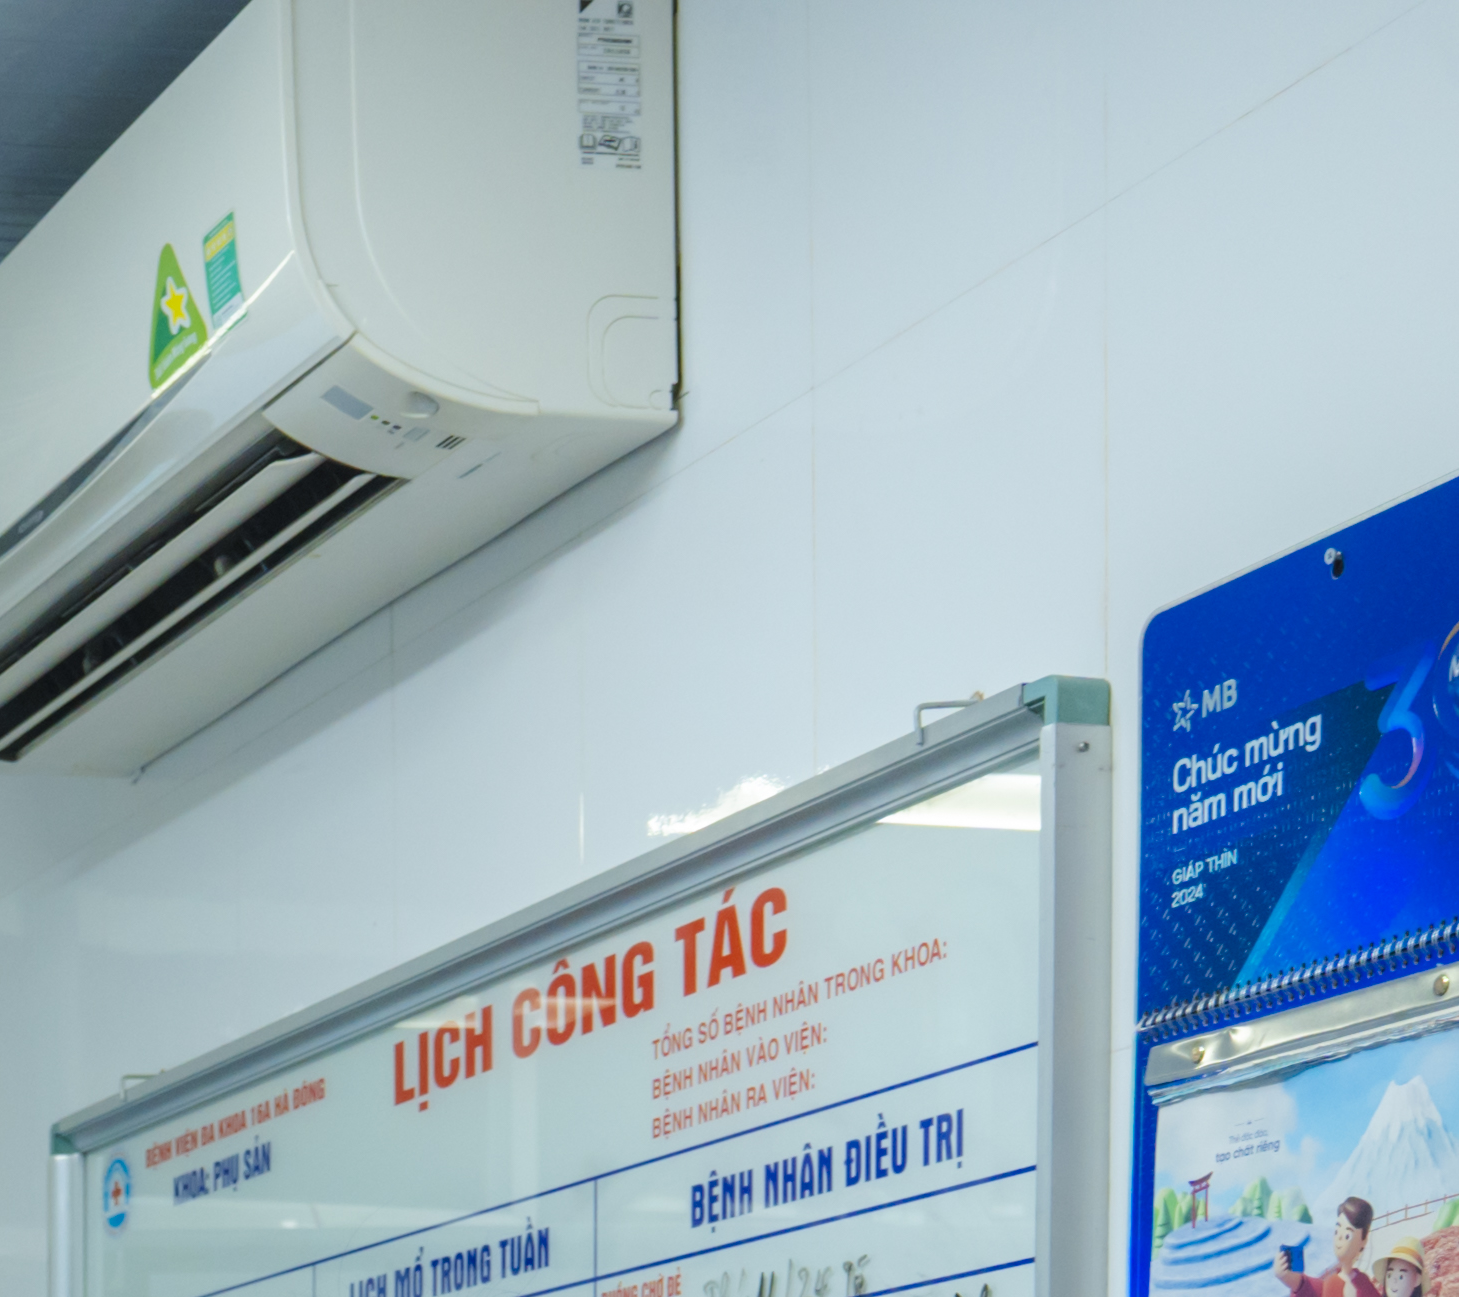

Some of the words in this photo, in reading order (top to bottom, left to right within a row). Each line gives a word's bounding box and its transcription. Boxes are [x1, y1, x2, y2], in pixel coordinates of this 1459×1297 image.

[1201, 678, 1237, 719] MB
[1173, 742, 1239, 793] Chúc
[1245, 714, 1323, 768] mừng
[1172, 791, 1226, 835] năm
[1233, 762, 1283, 812] mới
[1171, 860, 1204, 885] GIÁP
[1205, 848, 1238, 873] THÌN
[1171, 883, 1204, 908] 2024
[393, 1004, 494, 1113] LỊCH
[511, 957, 656, 1060] CÔNG
[674, 885, 789, 998] TÁC
[652, 1021, 694, 1061] TỔNG
[697, 1006, 721, 1044] SỐ
[723, 998, 768, 1037] BỆNH
[772, 980, 820, 1018] NHÂN
[823, 957, 886, 1005] TRONG
[891, 938, 948, 979] KHOA:
[652, 1066, 694, 1102] BỆNH
[697, 1047, 742, 1089] NHÂN
[745, 1034, 780, 1071] VÀO
[783, 1021, 828, 1058] VIỆN:
[218, 1108, 247, 1141] KHOA
[251, 1099, 271, 1127] 16A
[652, 1107, 694, 1141] BỆNH
[697, 1088, 742, 1129] NHÂN
[745, 1082, 769, 1114] RA
[770, 1067, 817, 1106] VIỆN:
[213, 1152, 239, 1191] PHỤ
[691, 1169, 754, 1235] BỆNH
[764, 1142, 834, 1211] NHÂN
[844, 1111, 909, 1190] ĐIỀU
[919, 1108, 965, 1170] TRỊ
[430, 1244, 491, 1297] TRONG
[498, 1215, 550, 1279] TUẦN
